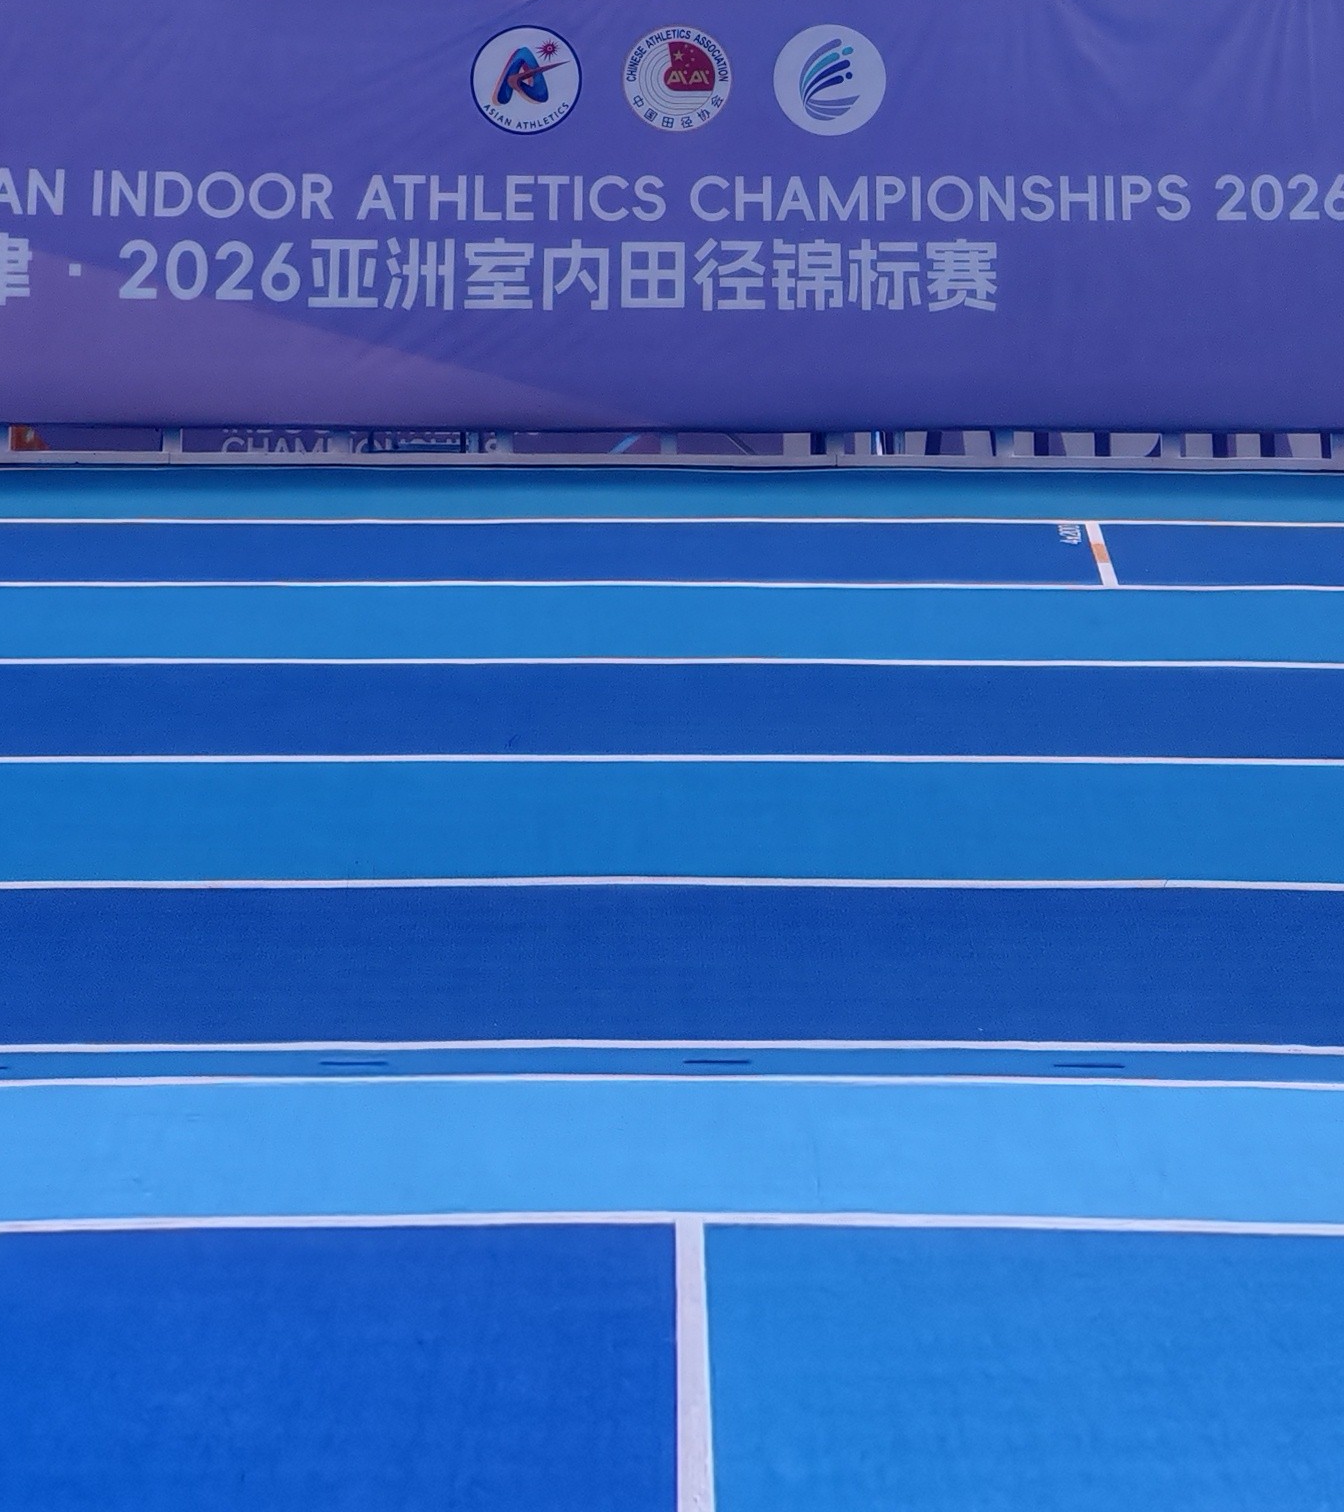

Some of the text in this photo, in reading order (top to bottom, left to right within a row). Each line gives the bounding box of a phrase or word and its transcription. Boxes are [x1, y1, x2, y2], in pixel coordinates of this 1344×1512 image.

[626, 29, 729, 83] CHINESE ATHLETICS ASSOCIATION
[483, 102, 570, 130] ASIAN ATHLETICS
[632, 94, 724, 129] 中国田径协会
[92, 168, 333, 221] INDOOR
[357, 173, 665, 223] ATHLETICS
[690, 173, 1191, 223] CHAMPIONSHIPS
